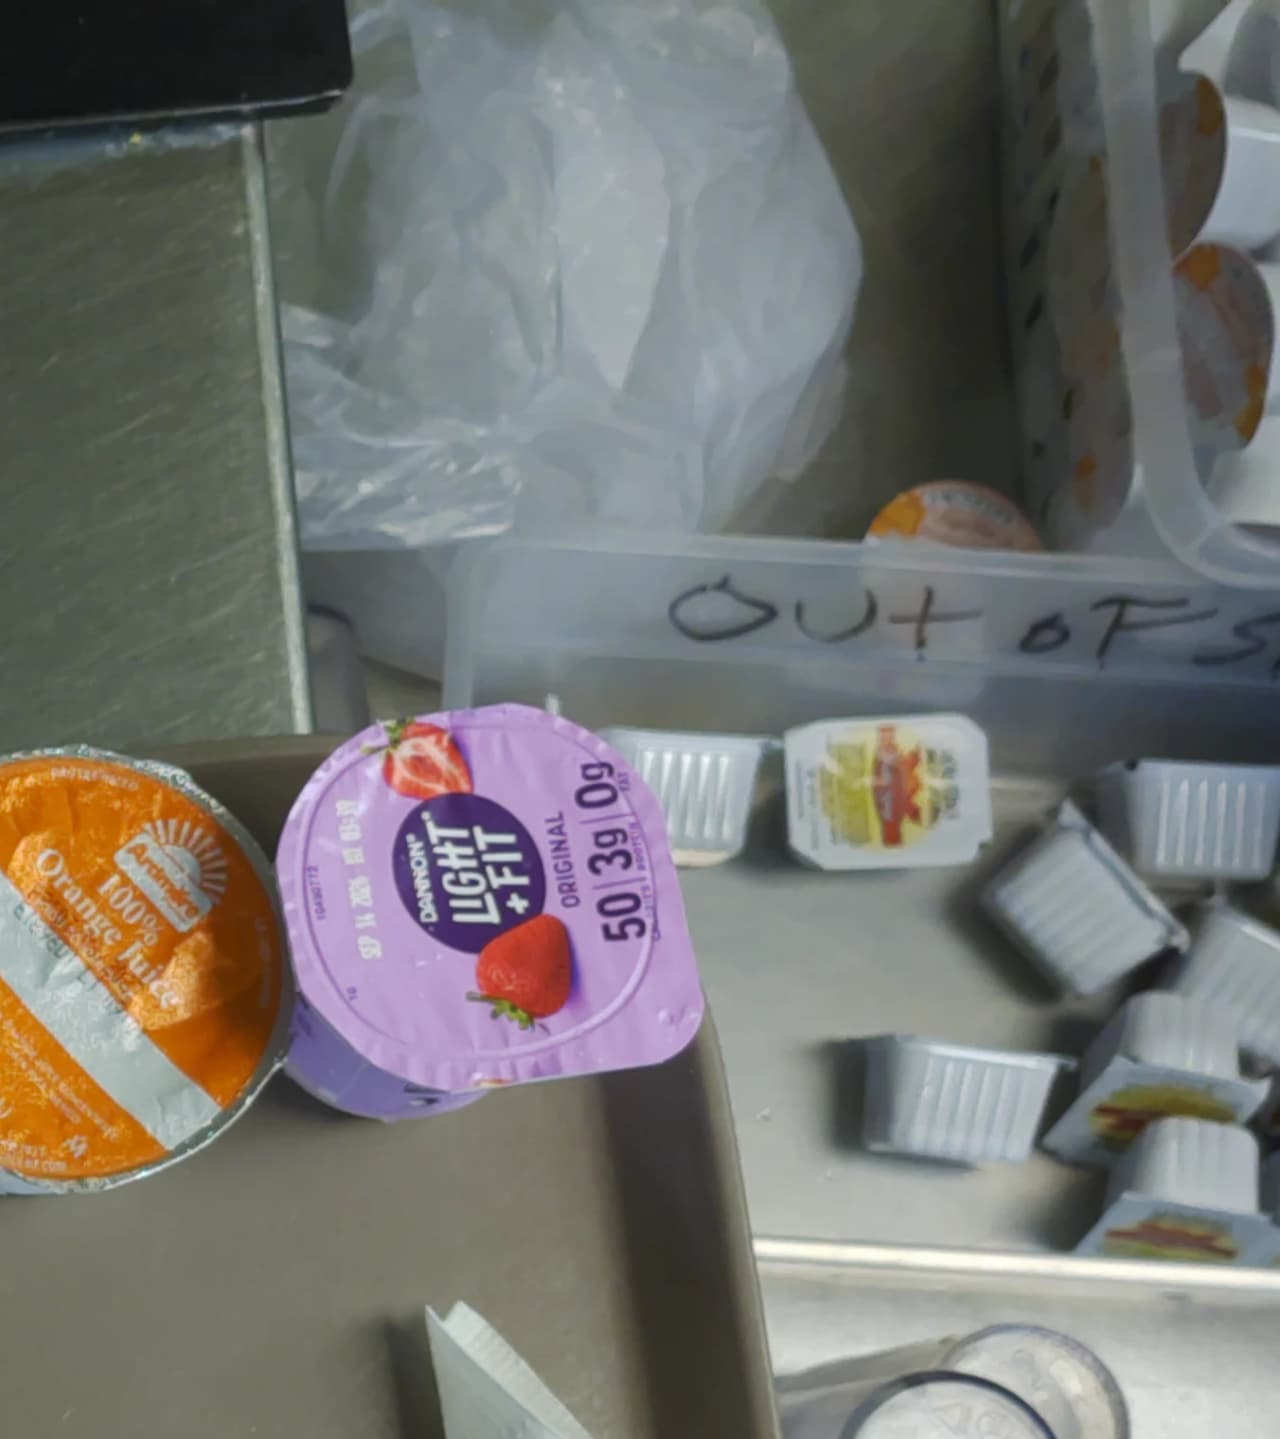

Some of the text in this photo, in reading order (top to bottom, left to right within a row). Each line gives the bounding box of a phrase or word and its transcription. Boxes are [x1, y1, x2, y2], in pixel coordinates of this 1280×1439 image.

[427, 814, 500, 926] LIGHT
[483, 824, 530, 890] FIT
[548, 811, 578, 908] ORIGINAL
[575, 760, 646, 942] 50 3g 0g
[31, 847, 127, 947] Orange
[119, 941, 184, 1008] Juice
[99, 876, 165, 945] 100%
